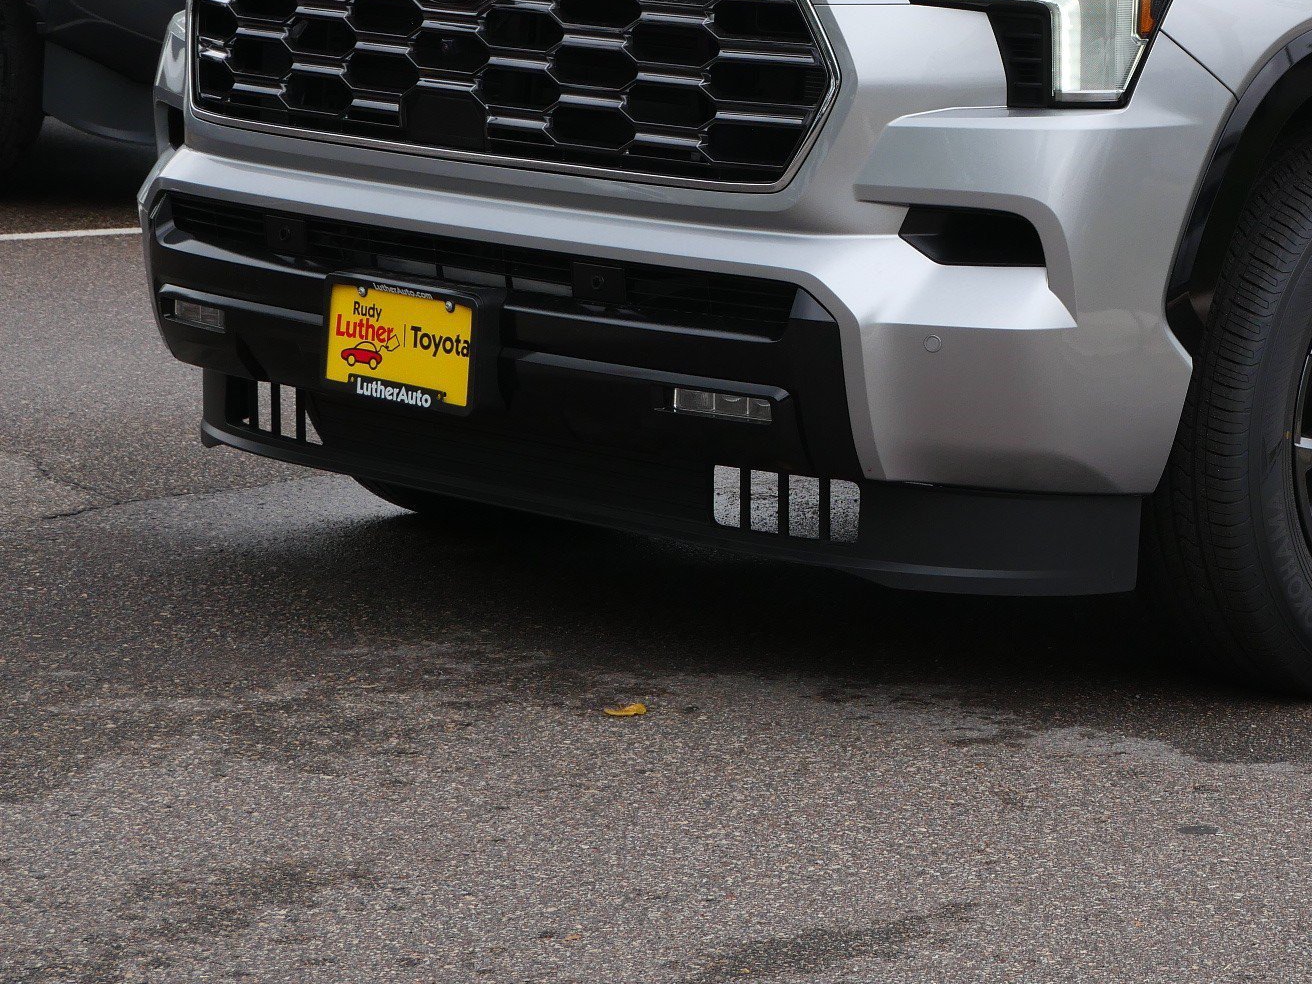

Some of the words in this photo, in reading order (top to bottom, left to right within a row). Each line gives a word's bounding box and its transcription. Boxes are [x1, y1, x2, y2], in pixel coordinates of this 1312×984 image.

[352, 301, 382, 322] Rudy
[335, 314, 394, 343] Luther
[410, 325, 471, 358] Toyota
[356, 377, 432, 408] LutherAuto
